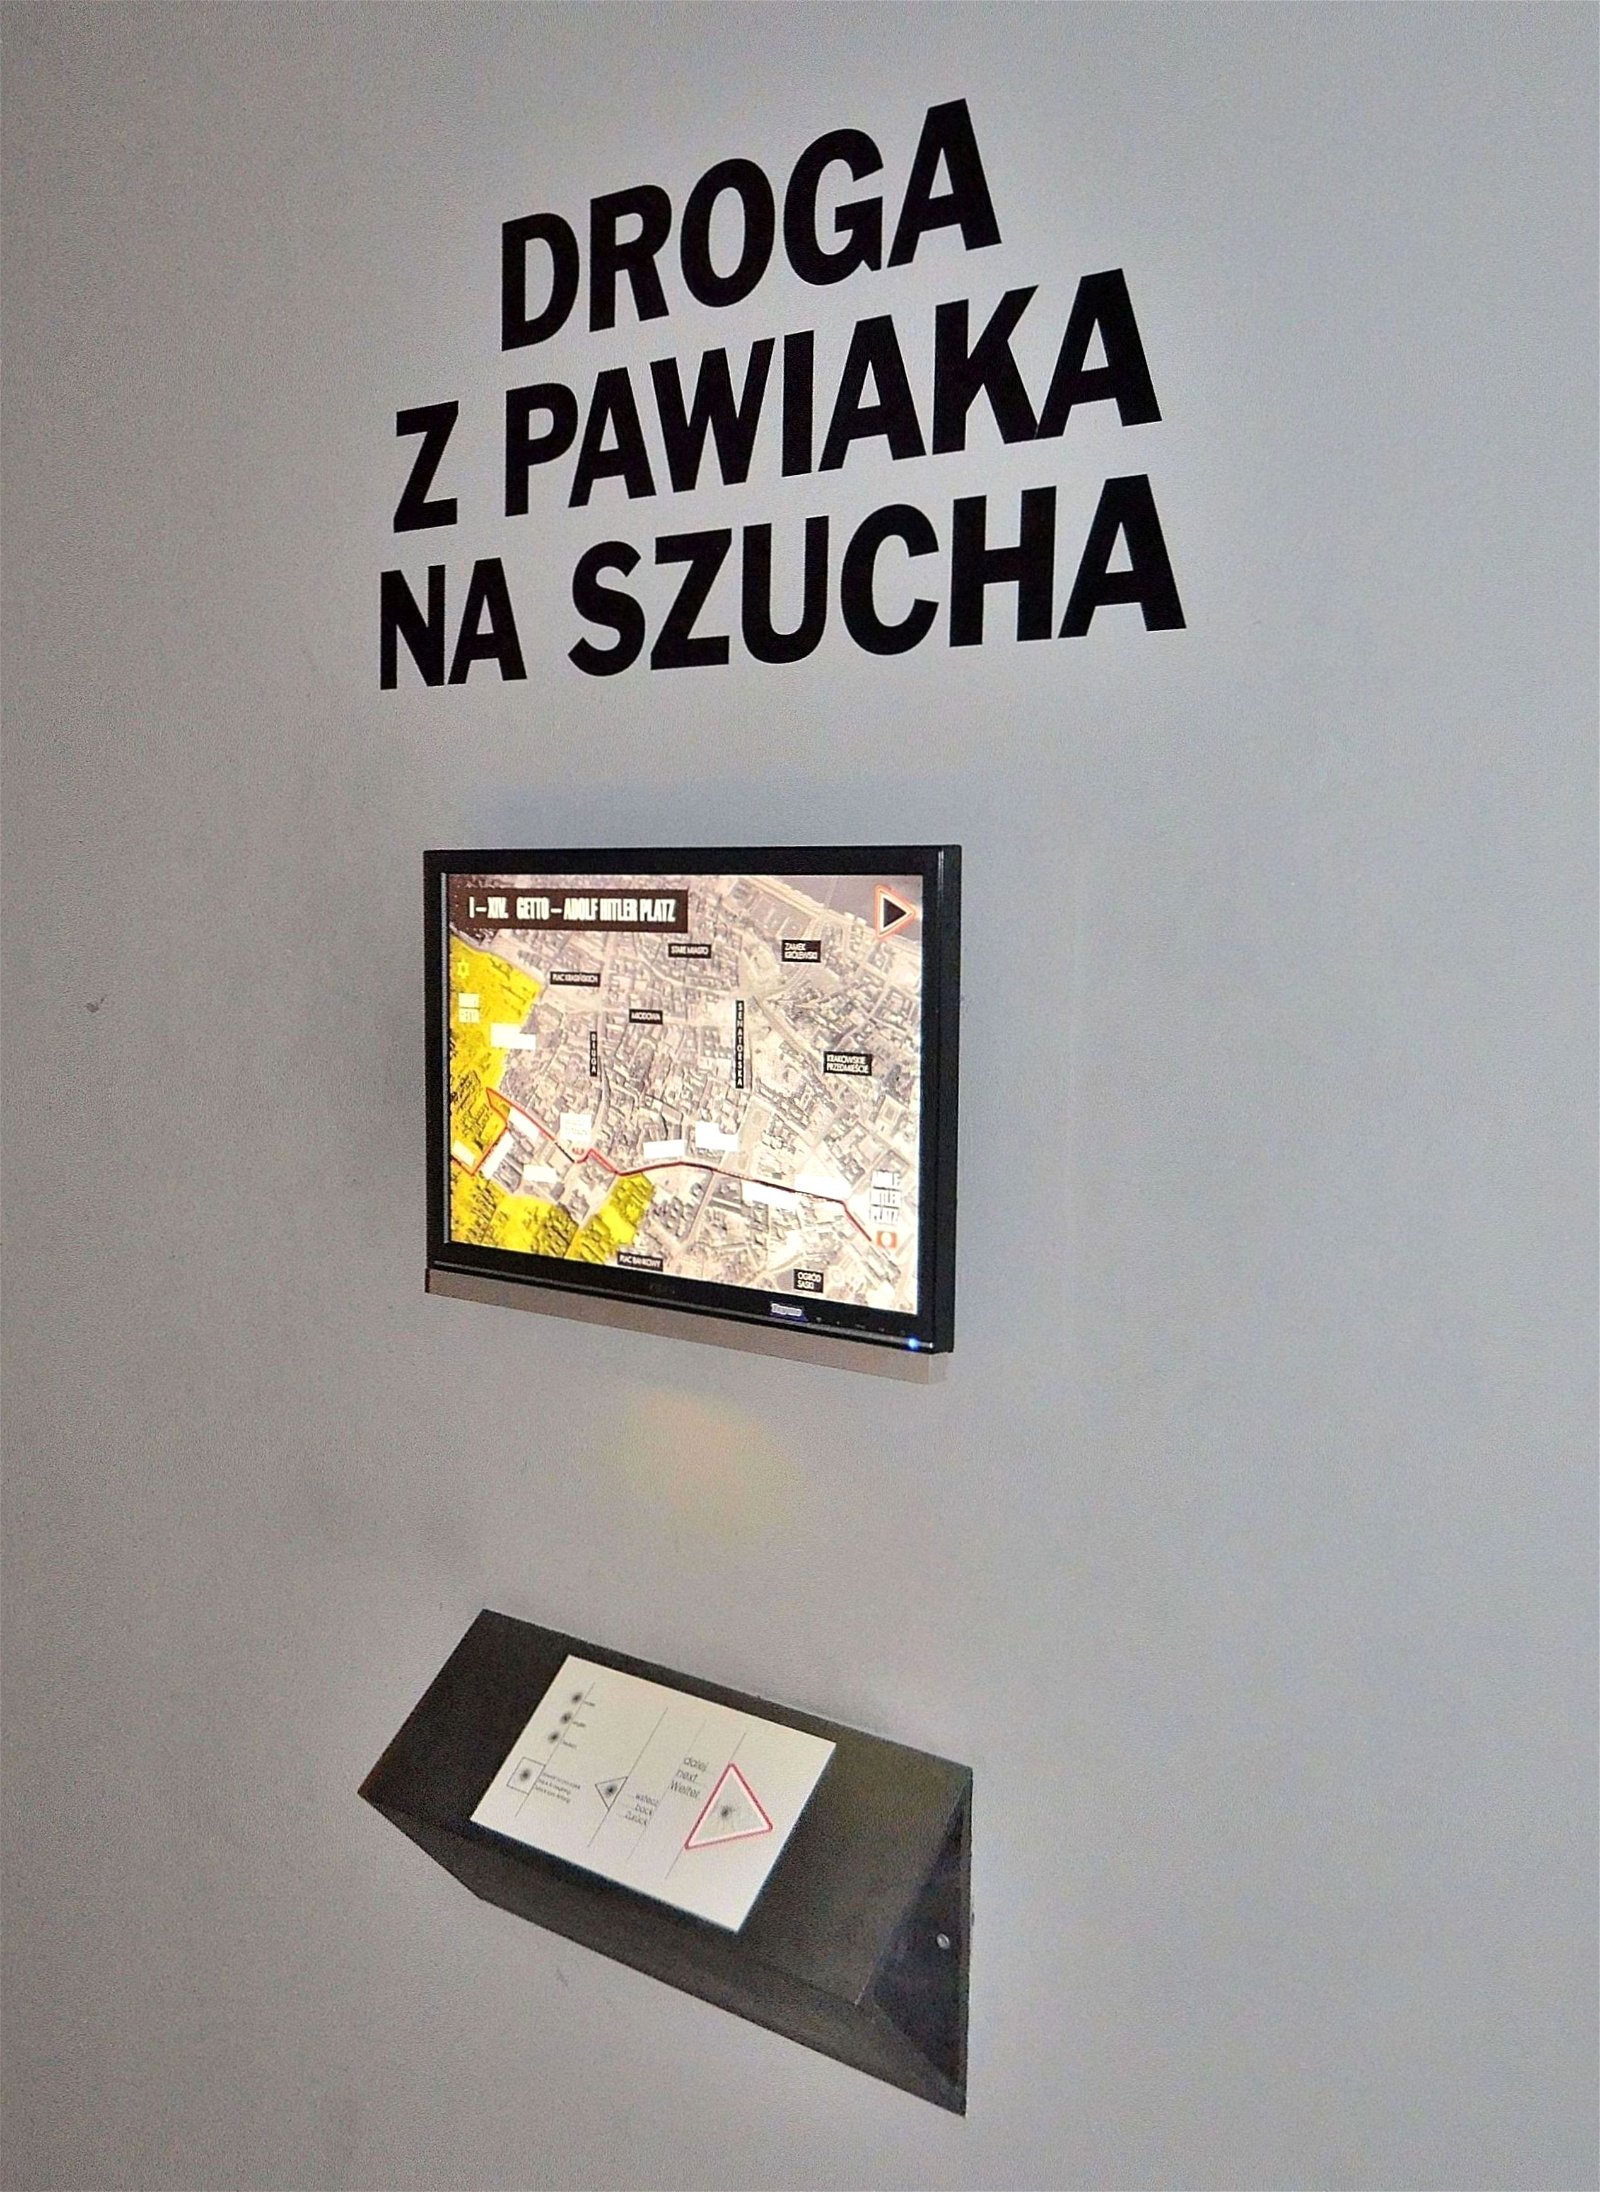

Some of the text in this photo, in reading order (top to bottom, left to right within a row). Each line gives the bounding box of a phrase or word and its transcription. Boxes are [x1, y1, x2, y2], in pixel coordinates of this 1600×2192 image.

[501, 98, 1002, 352] DROGA
[393, 268, 1162, 533] Z PAWIAKA
[380, 474, 1186, 690] NA SZUCHA
[516, 896, 550, 920] GETTO
[563, 897, 599, 921] ADOLF
[599, 898, 638, 922] HITLER
[639, 898, 677, 923] PLATZ
